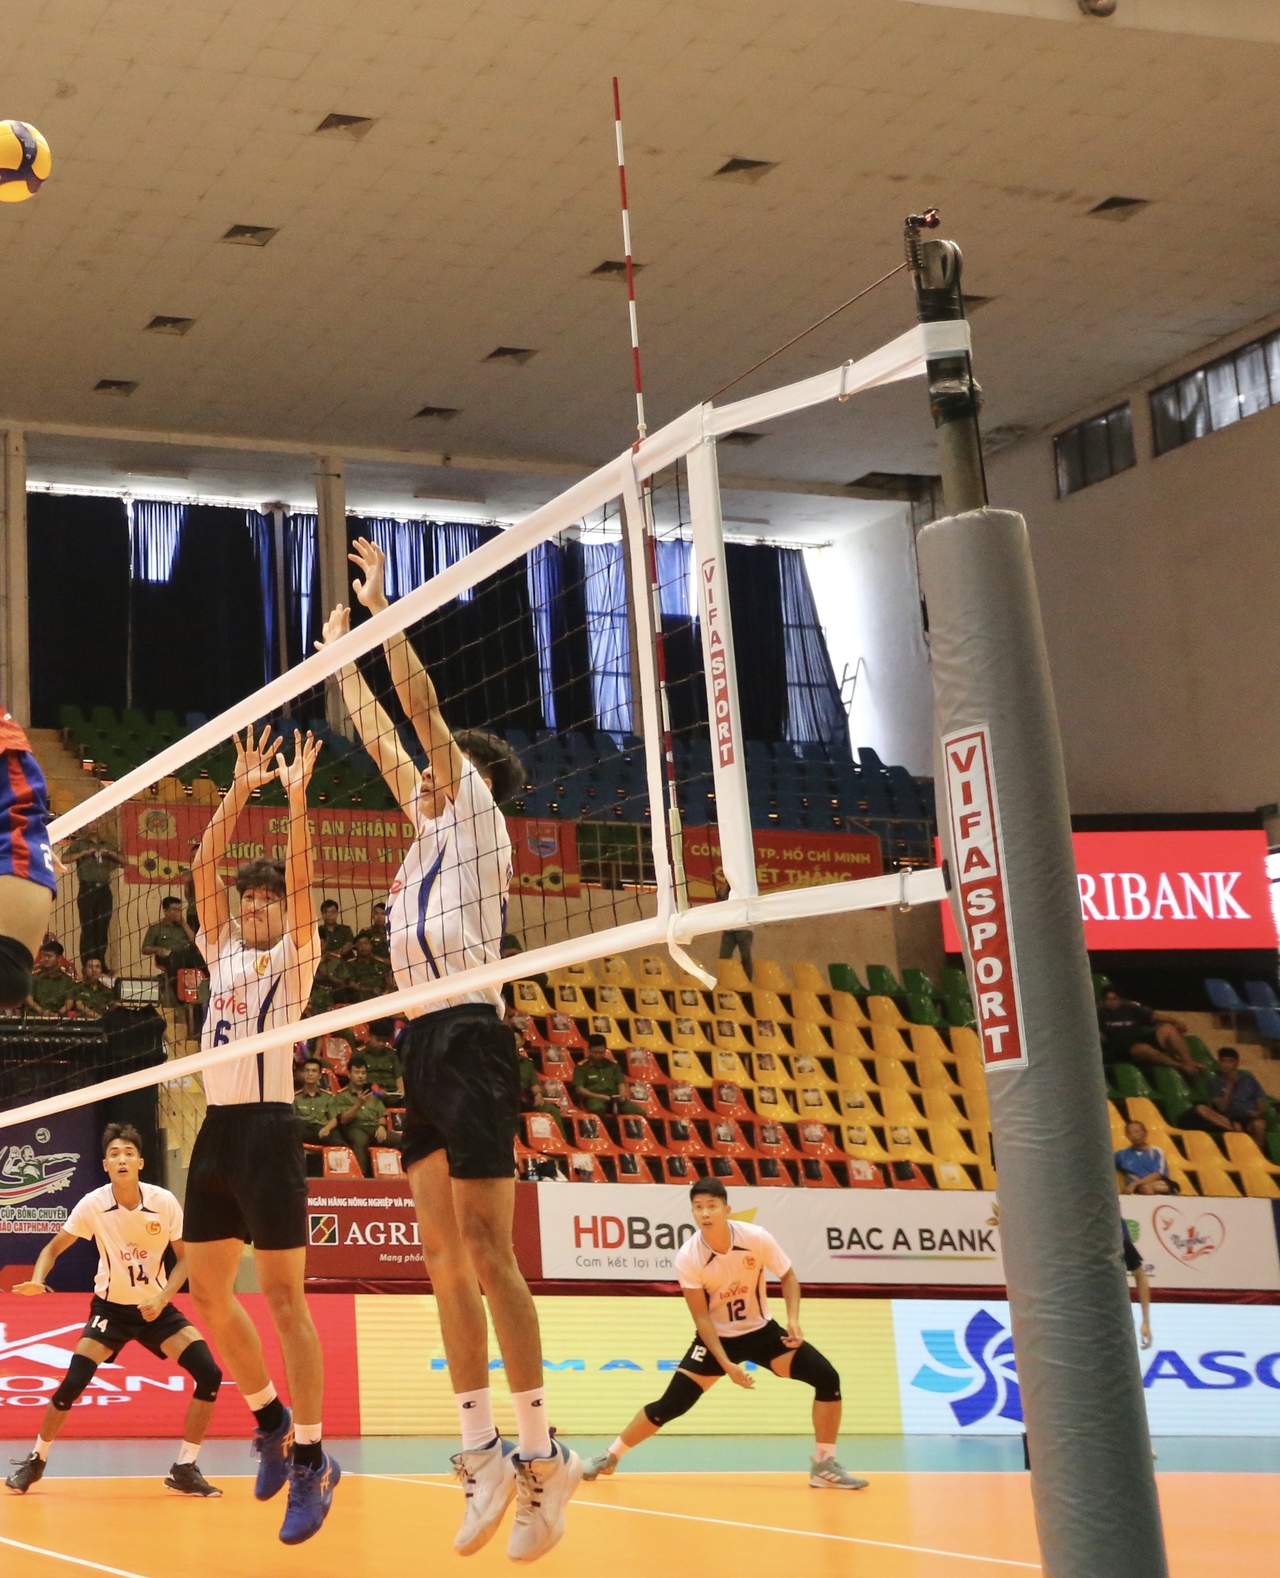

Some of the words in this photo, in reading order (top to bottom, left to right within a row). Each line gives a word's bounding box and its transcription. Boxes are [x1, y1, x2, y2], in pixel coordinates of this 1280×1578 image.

[269, 815, 315, 834] CÔG
[321, 820, 345, 836] AN
[351, 819, 397, 838] NHÂN
[807, 850, 831, 862] CHÍ
[835, 852, 870, 865] MINH
[308, 1196, 327, 1207] NGÂN
[328, 1196, 347, 1207] HÀNG
[348, 1197, 367, 1207] NÔNG
[368, 1197, 393, 1209] NGHIỆP
[394, 1197, 404, 1207] VÀ
[1, 1206, 15, 1219] CÚP
[826, 1227, 884, 1250] BAC
[892, 1228, 912, 1250] A
[918, 1228, 996, 1252] BANK
[379, 1254, 403, 1263] Mang
[576, 1255, 602, 1268] Cam
[607, 1252, 628, 1268] kết
[127, 1264, 149, 1287] 14
[726, 1298, 746, 1322] 12
[91, 1315, 108, 1333] 14
[691, 1344, 707, 1362] 12
